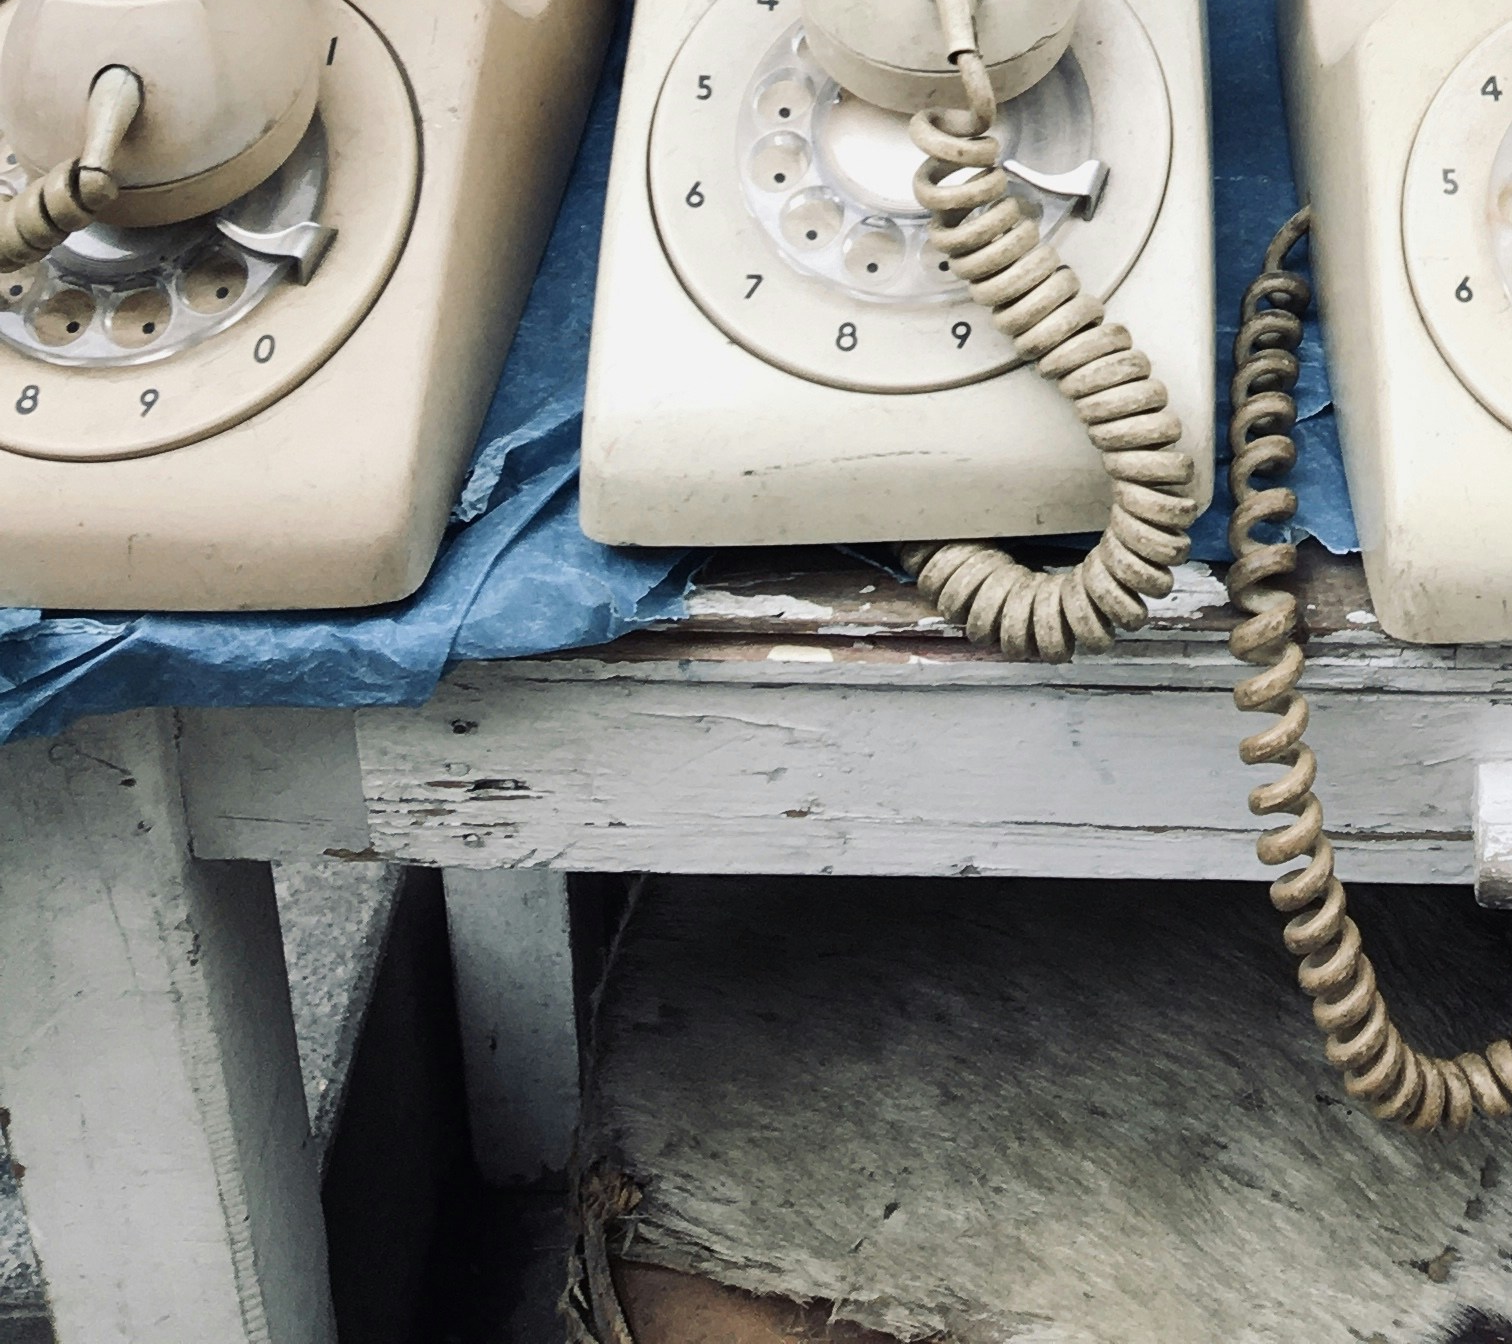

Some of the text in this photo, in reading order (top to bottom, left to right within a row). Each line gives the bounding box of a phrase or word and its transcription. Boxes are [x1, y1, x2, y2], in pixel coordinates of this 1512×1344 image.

[697, 75, 712, 100] 5
[1481, 76, 1502, 101] 4
[686, 181, 704, 208] 6
[1443, 169, 1458, 195] 5
[745, 274, 763, 299] 7
[1455, 276, 1473, 302] 6
[254, 335, 275, 363] 0
[836, 322, 857, 352] 8
[952, 322, 971, 349] 9
[15, 385, 39, 415] 8
[140, 389, 159, 417] 9
